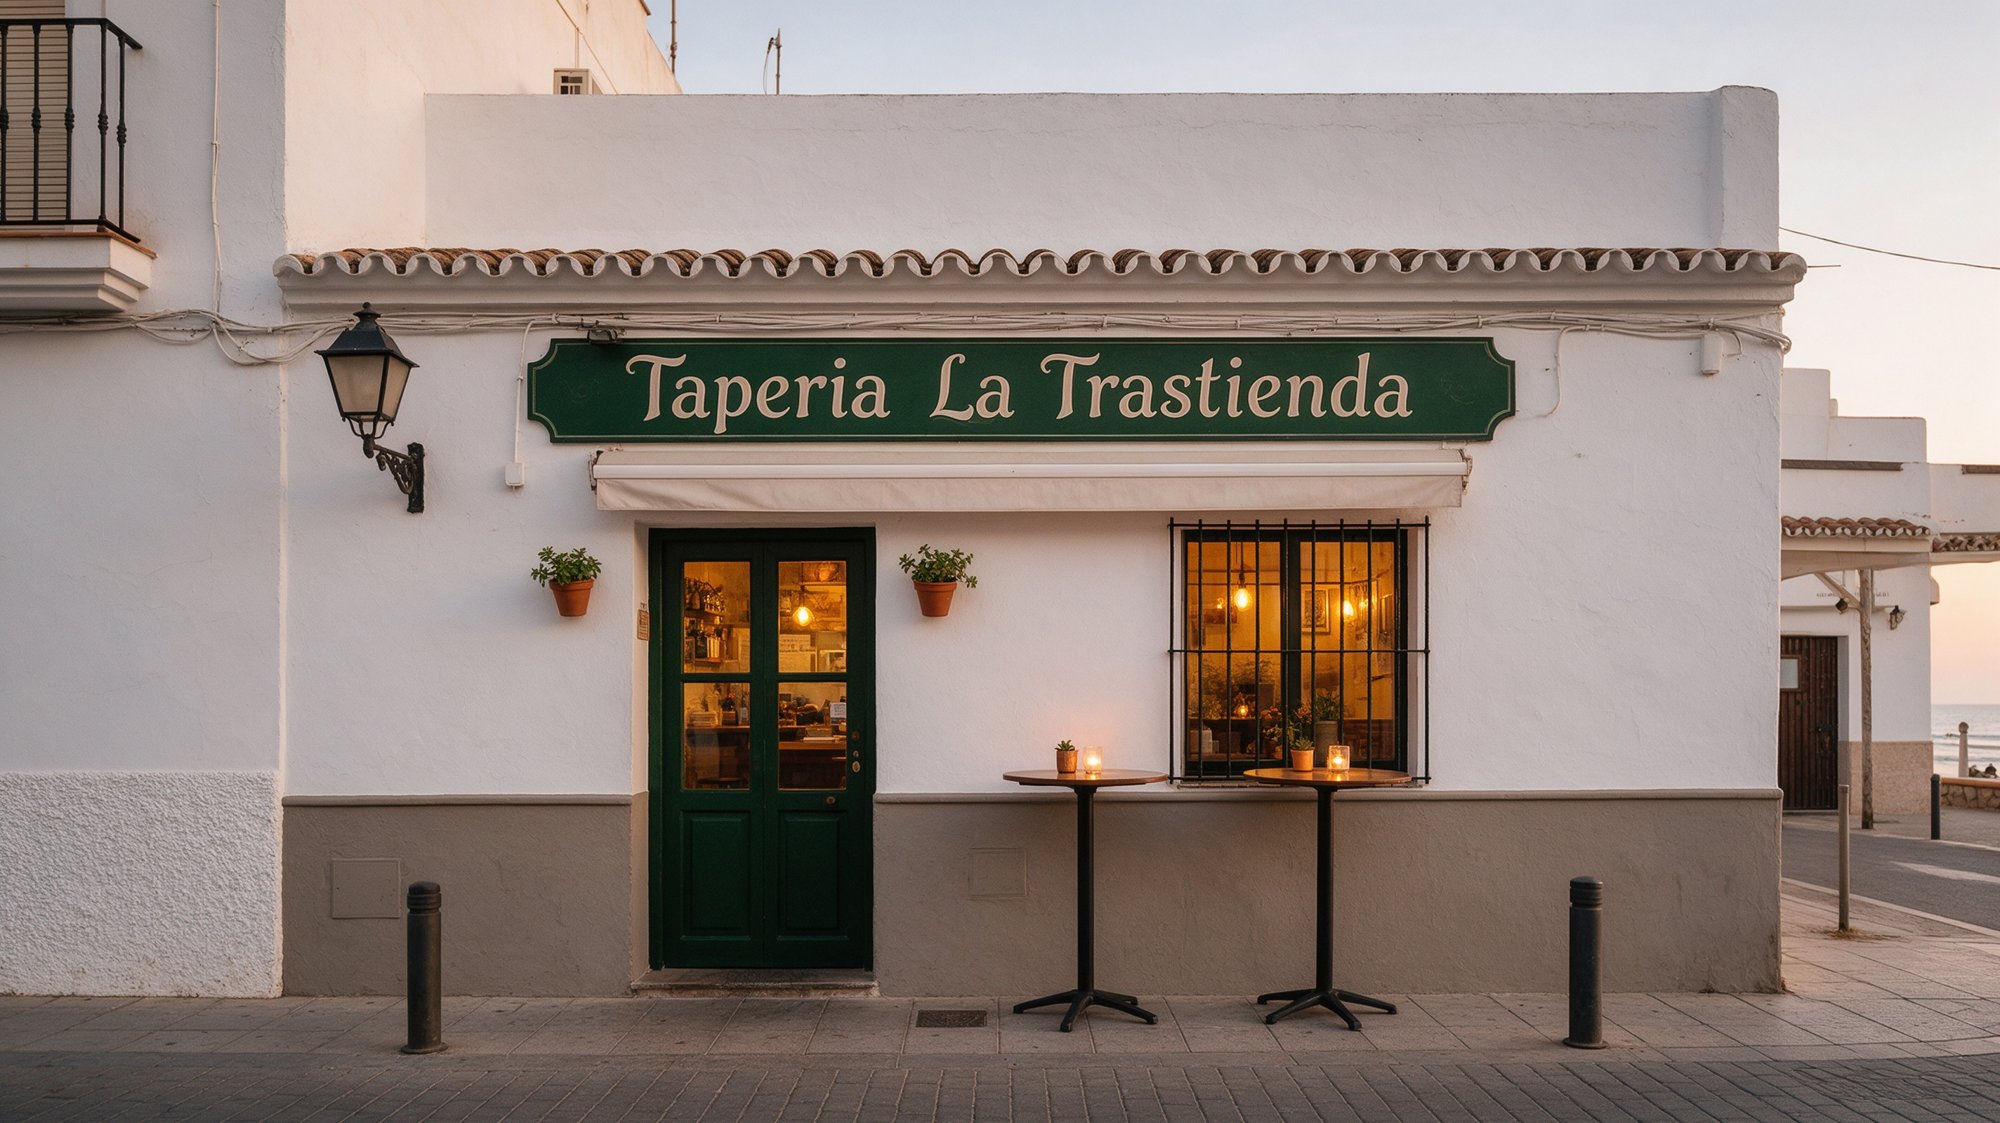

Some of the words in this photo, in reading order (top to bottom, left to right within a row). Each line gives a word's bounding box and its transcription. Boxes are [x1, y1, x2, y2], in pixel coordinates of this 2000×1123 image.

[625, 353, 891, 434] Taperia
[929, 353, 1015, 421] La
[1040, 352, 1413, 420] Trastienda
